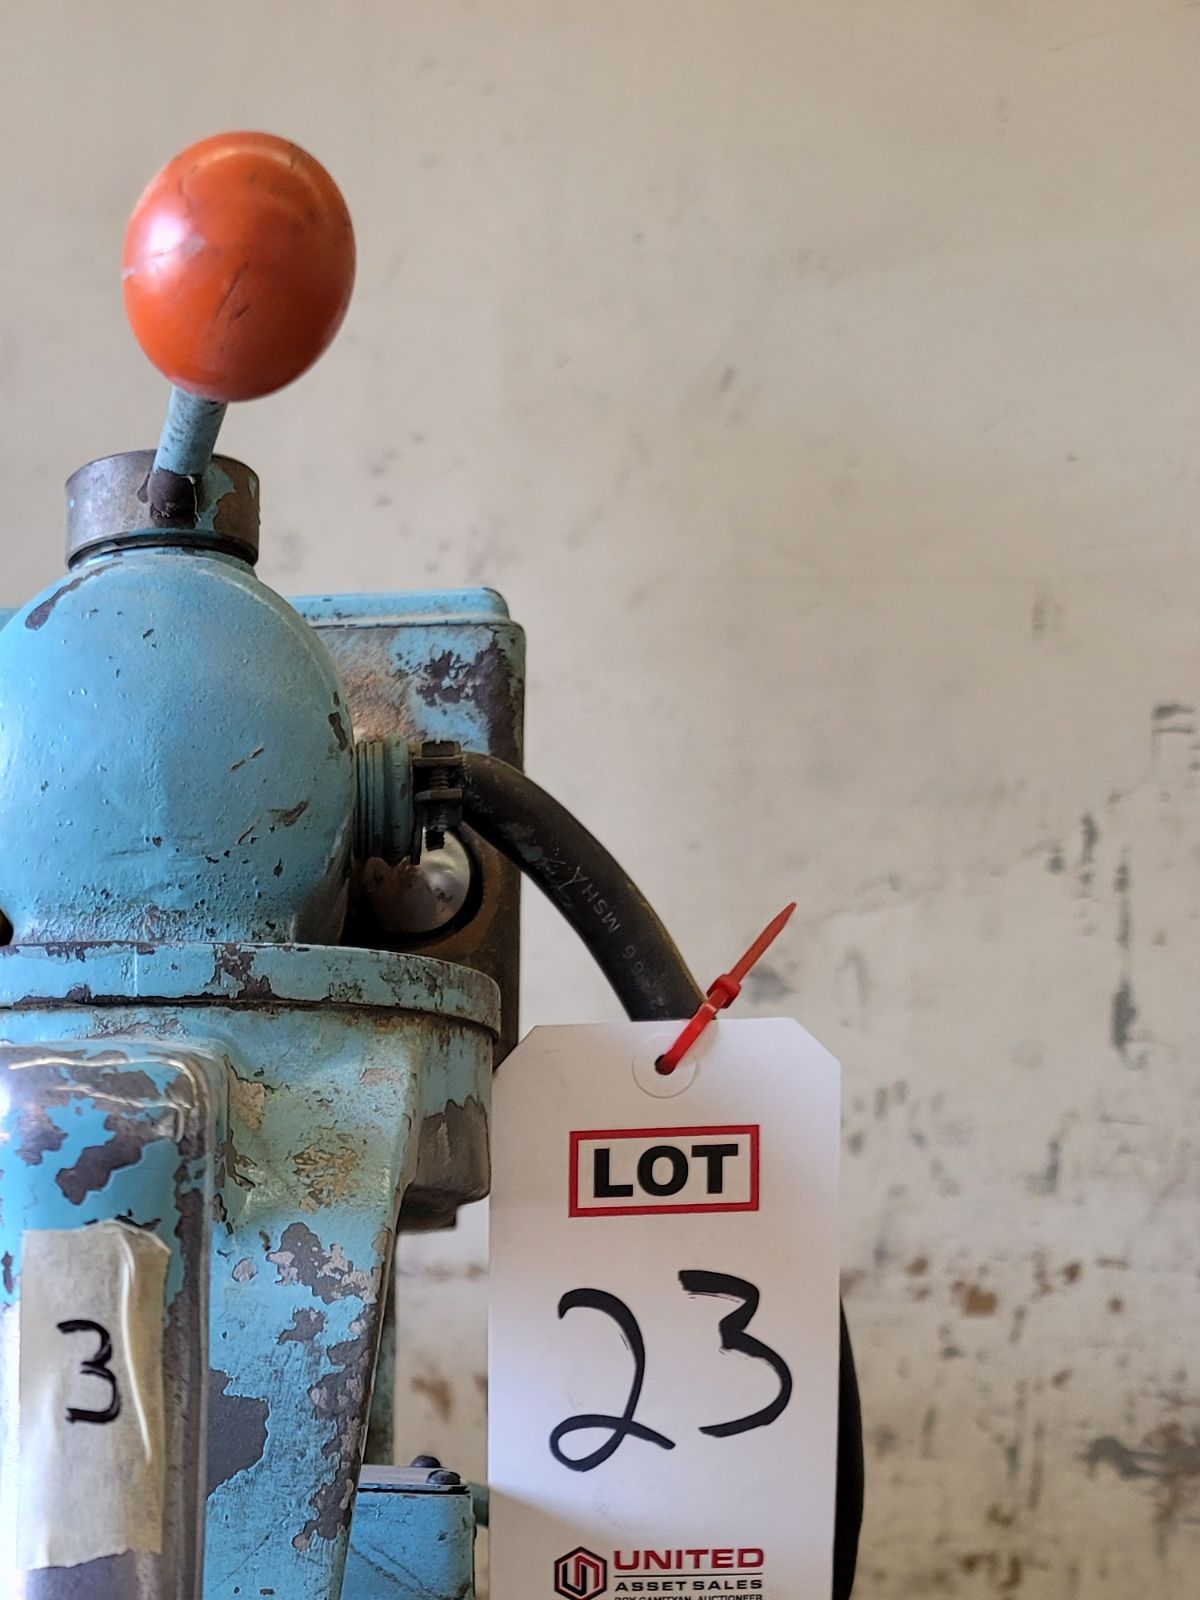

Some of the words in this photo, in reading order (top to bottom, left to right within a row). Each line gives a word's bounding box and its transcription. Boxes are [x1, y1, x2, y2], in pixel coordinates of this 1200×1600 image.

[593, 1143, 739, 1199] LOT
[57, 1319, 121, 1425] 3
[549, 1269, 793, 1473] 23
[614, 1548, 764, 1570] UNITED
[615, 1581, 686, 1592] ASSET
[693, 1579, 763, 1591] SALES
